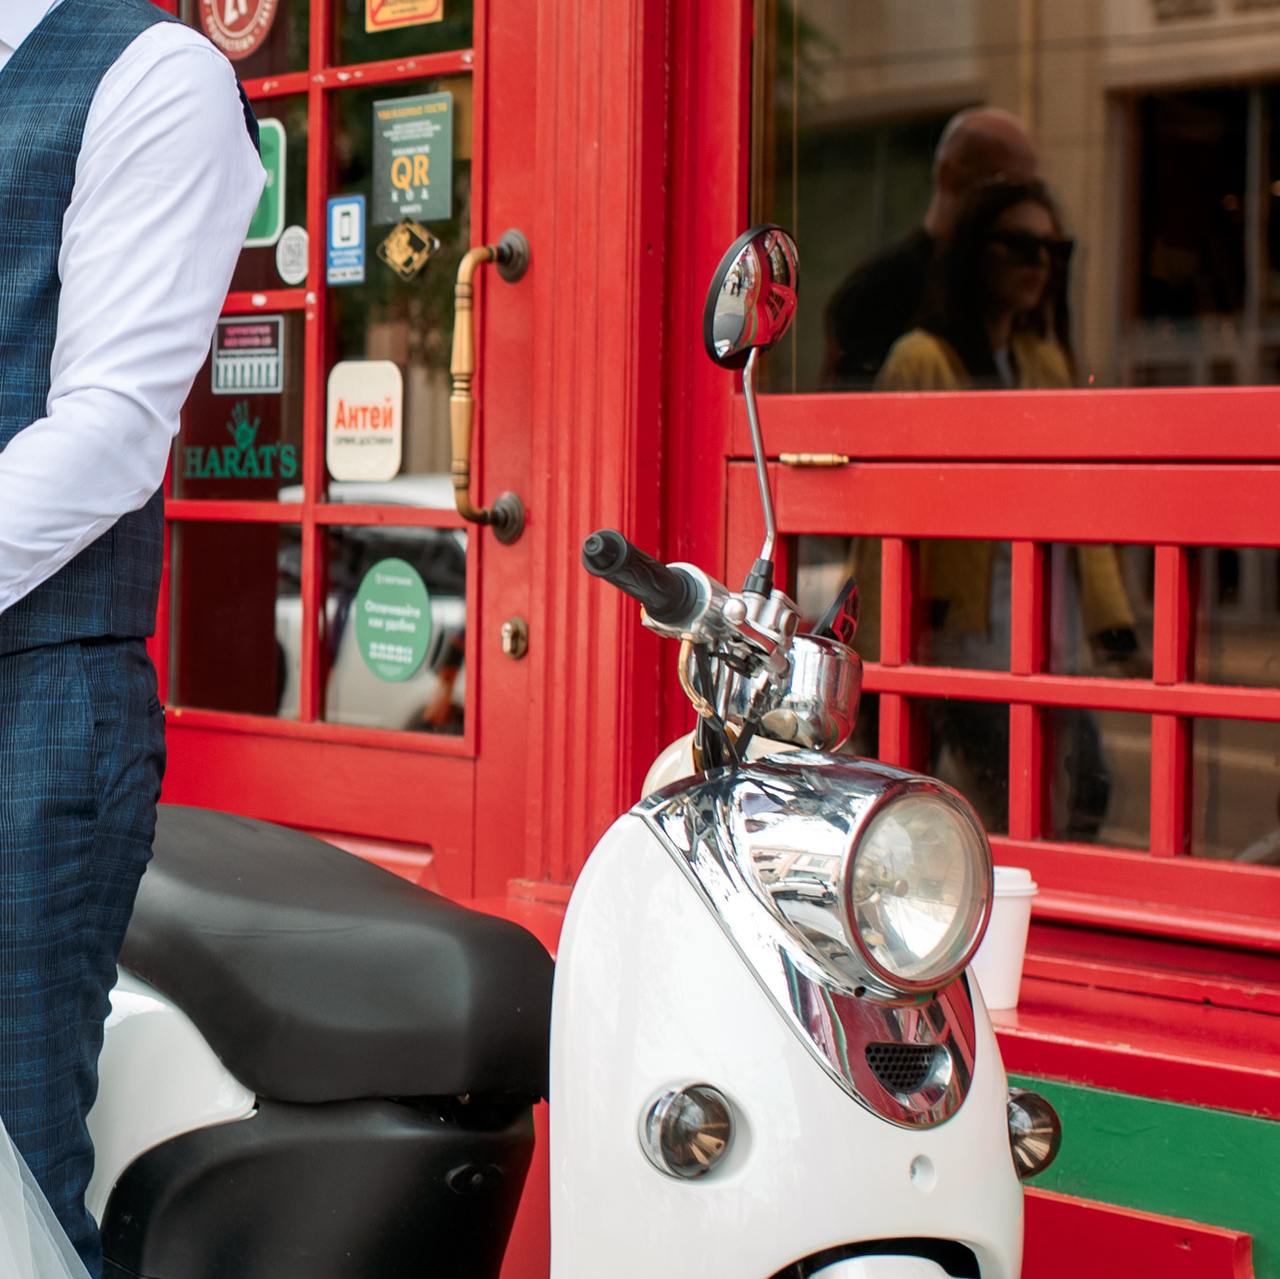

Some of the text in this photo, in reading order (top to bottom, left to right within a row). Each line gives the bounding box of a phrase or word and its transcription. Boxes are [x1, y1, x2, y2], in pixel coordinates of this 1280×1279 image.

[391, 154, 430, 191] QR
[334, 397, 394, 431] Антей
[184, 441, 297, 479] HARAT'S
